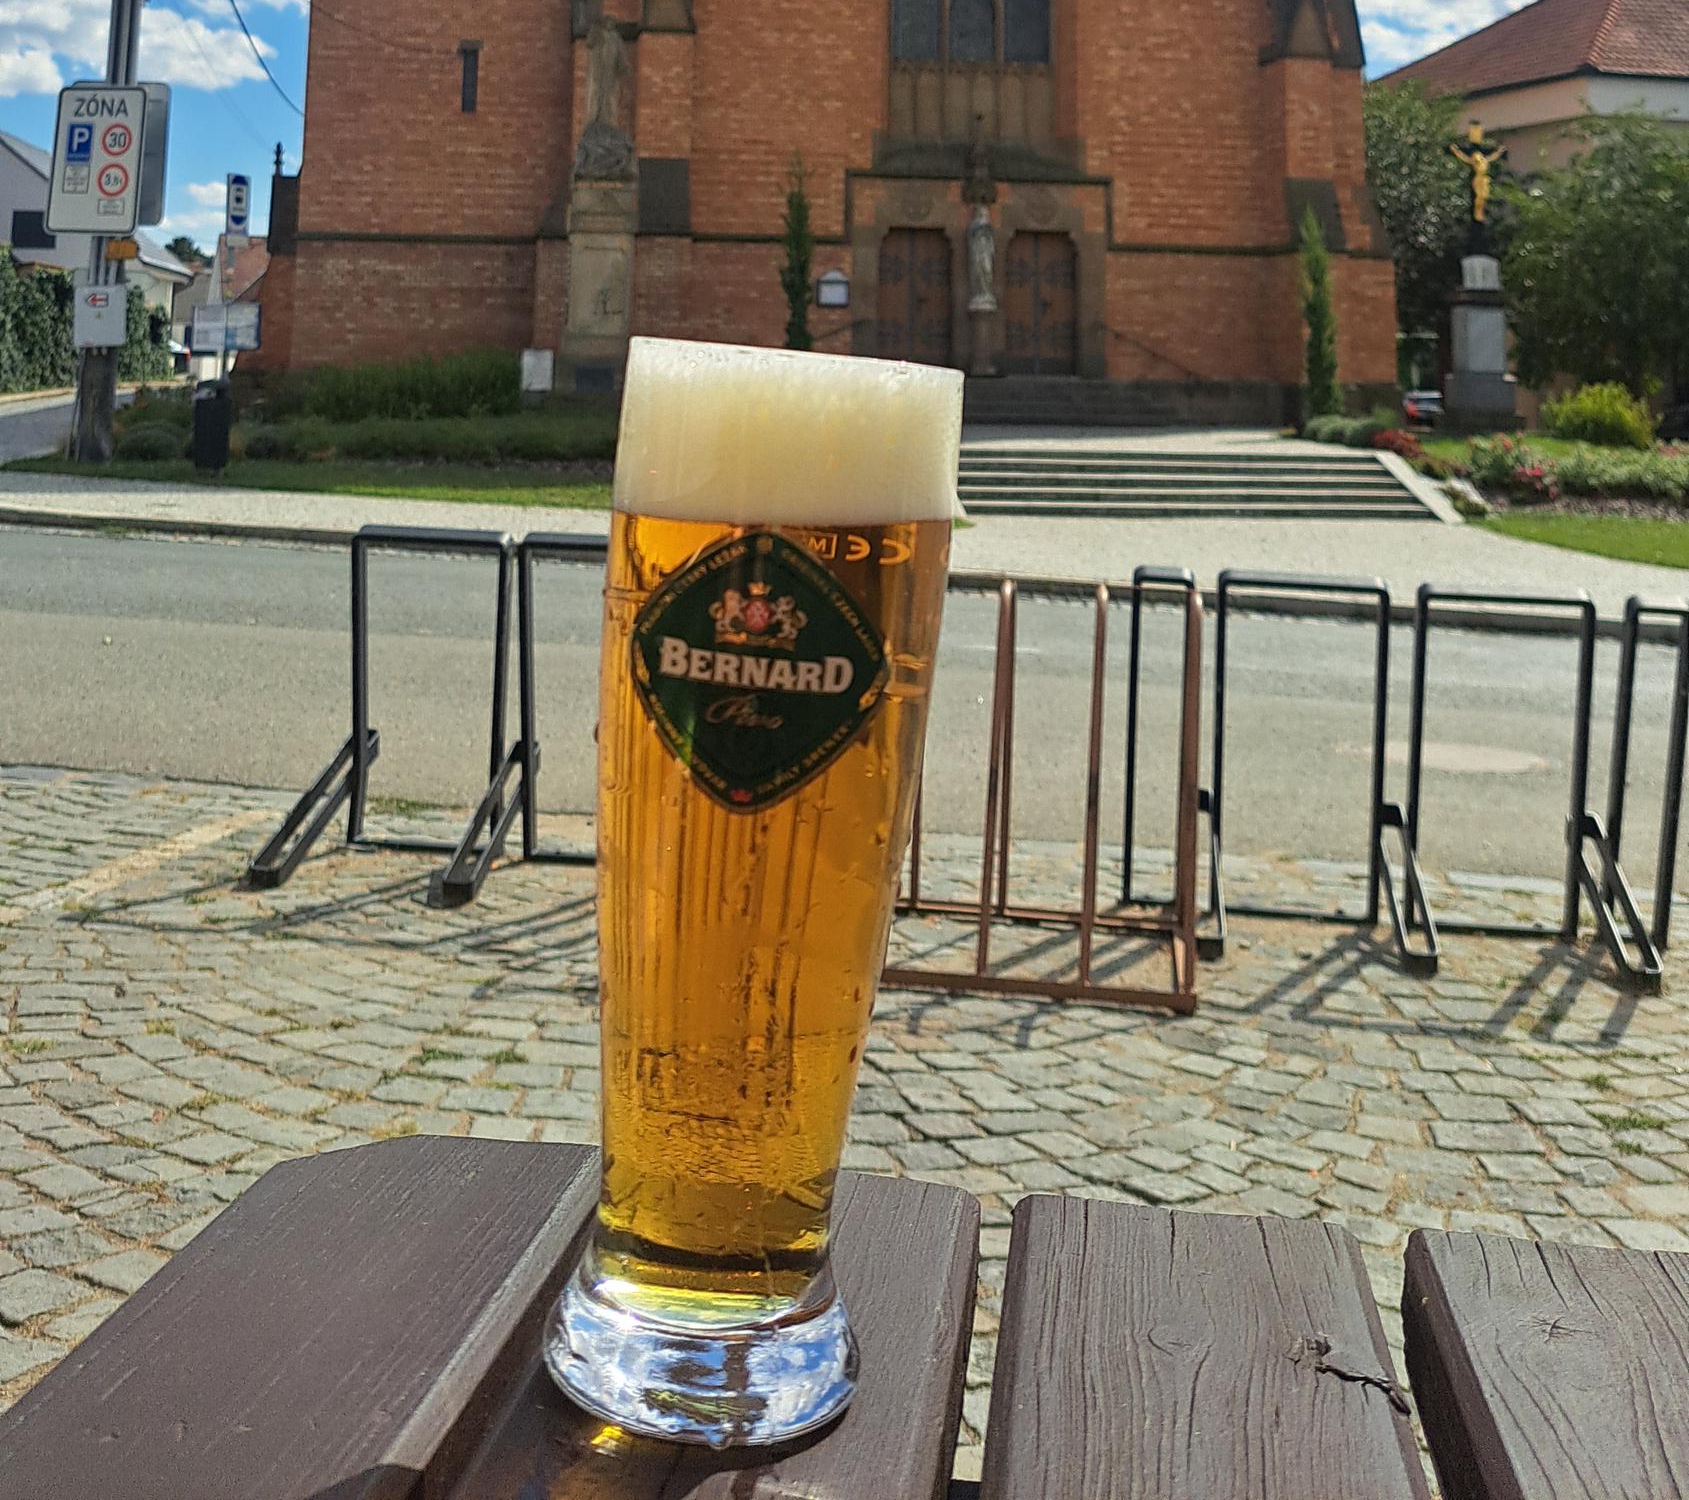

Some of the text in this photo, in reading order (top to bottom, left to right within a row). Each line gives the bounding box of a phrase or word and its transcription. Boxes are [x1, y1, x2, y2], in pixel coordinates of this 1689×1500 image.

[74, 94, 129, 117] ZÓNA
[72, 127, 90, 152] P
[109, 132, 127, 148] 30
[658, 635, 854, 694] BERNARD
